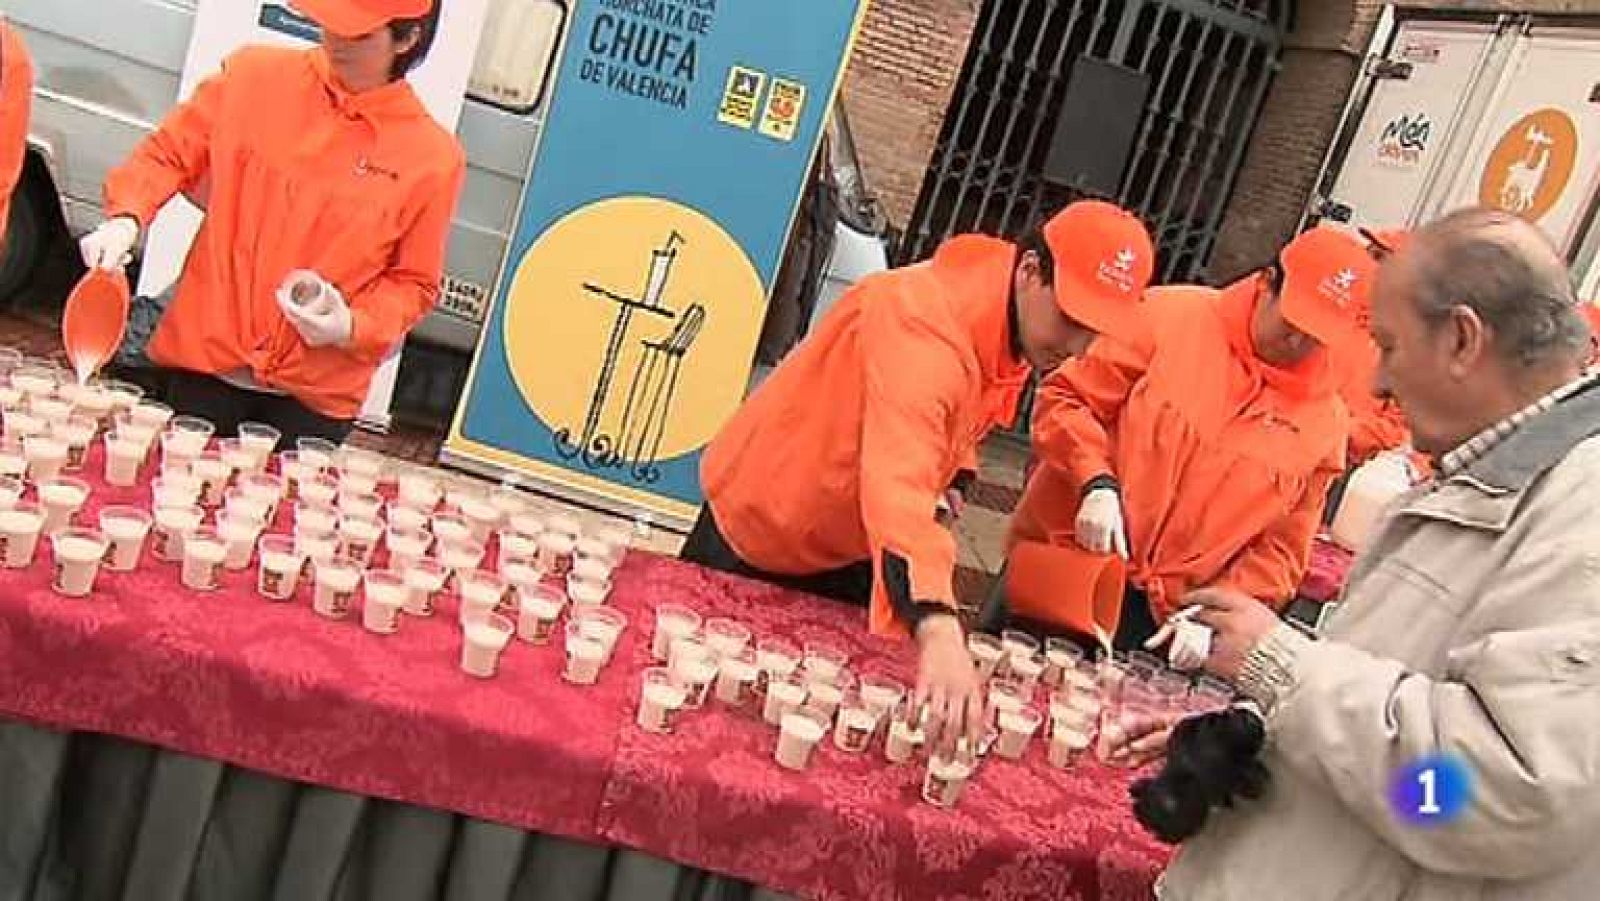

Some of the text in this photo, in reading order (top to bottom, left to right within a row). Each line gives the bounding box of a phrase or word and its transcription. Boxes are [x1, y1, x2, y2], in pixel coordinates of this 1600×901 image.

[599, 0, 683, 29] RCHATA
[687, 10, 712, 34] DE
[589, 13, 697, 82] CHUFA
[579, 58, 605, 84] DE
[606, 65, 687, 110] VALENCIA
